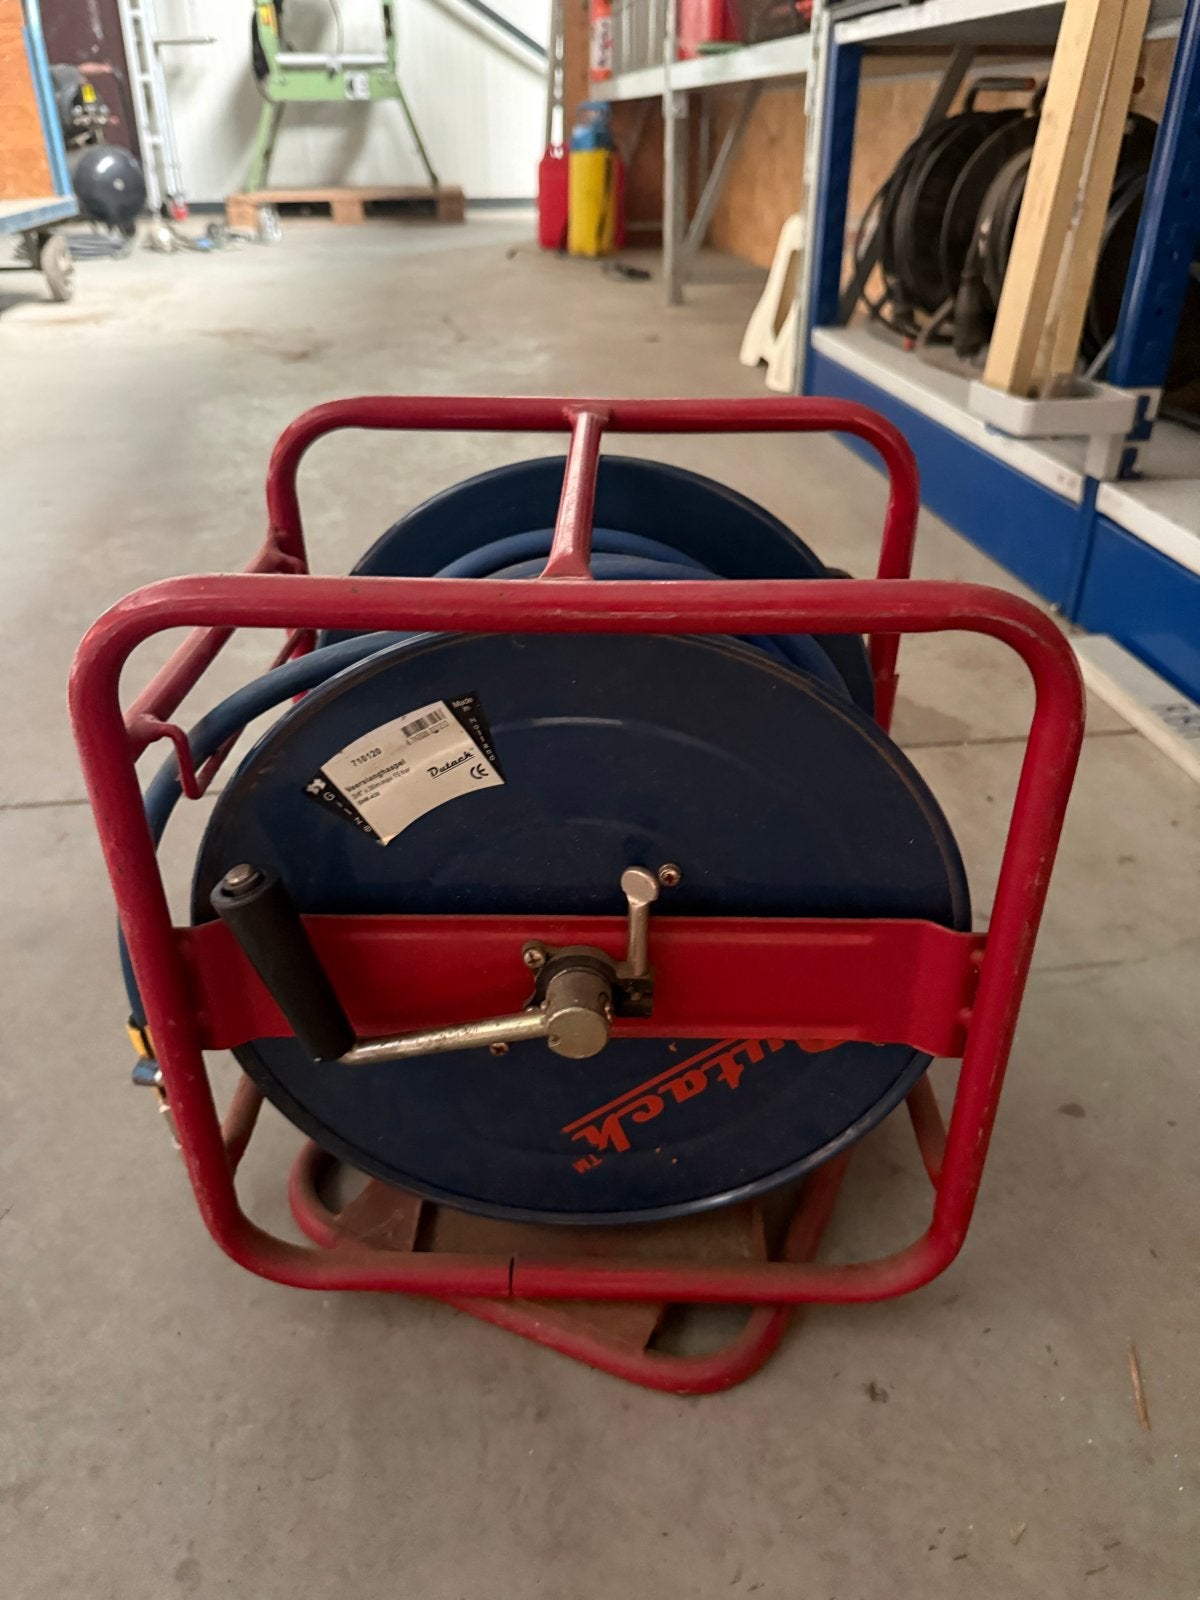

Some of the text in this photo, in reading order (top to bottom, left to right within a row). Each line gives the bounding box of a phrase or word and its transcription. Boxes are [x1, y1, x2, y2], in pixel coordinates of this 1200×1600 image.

[350, 747, 383, 767] 710120
[427, 751, 474, 777] Dutack
[571, 1038, 848, 1174] utack TM
